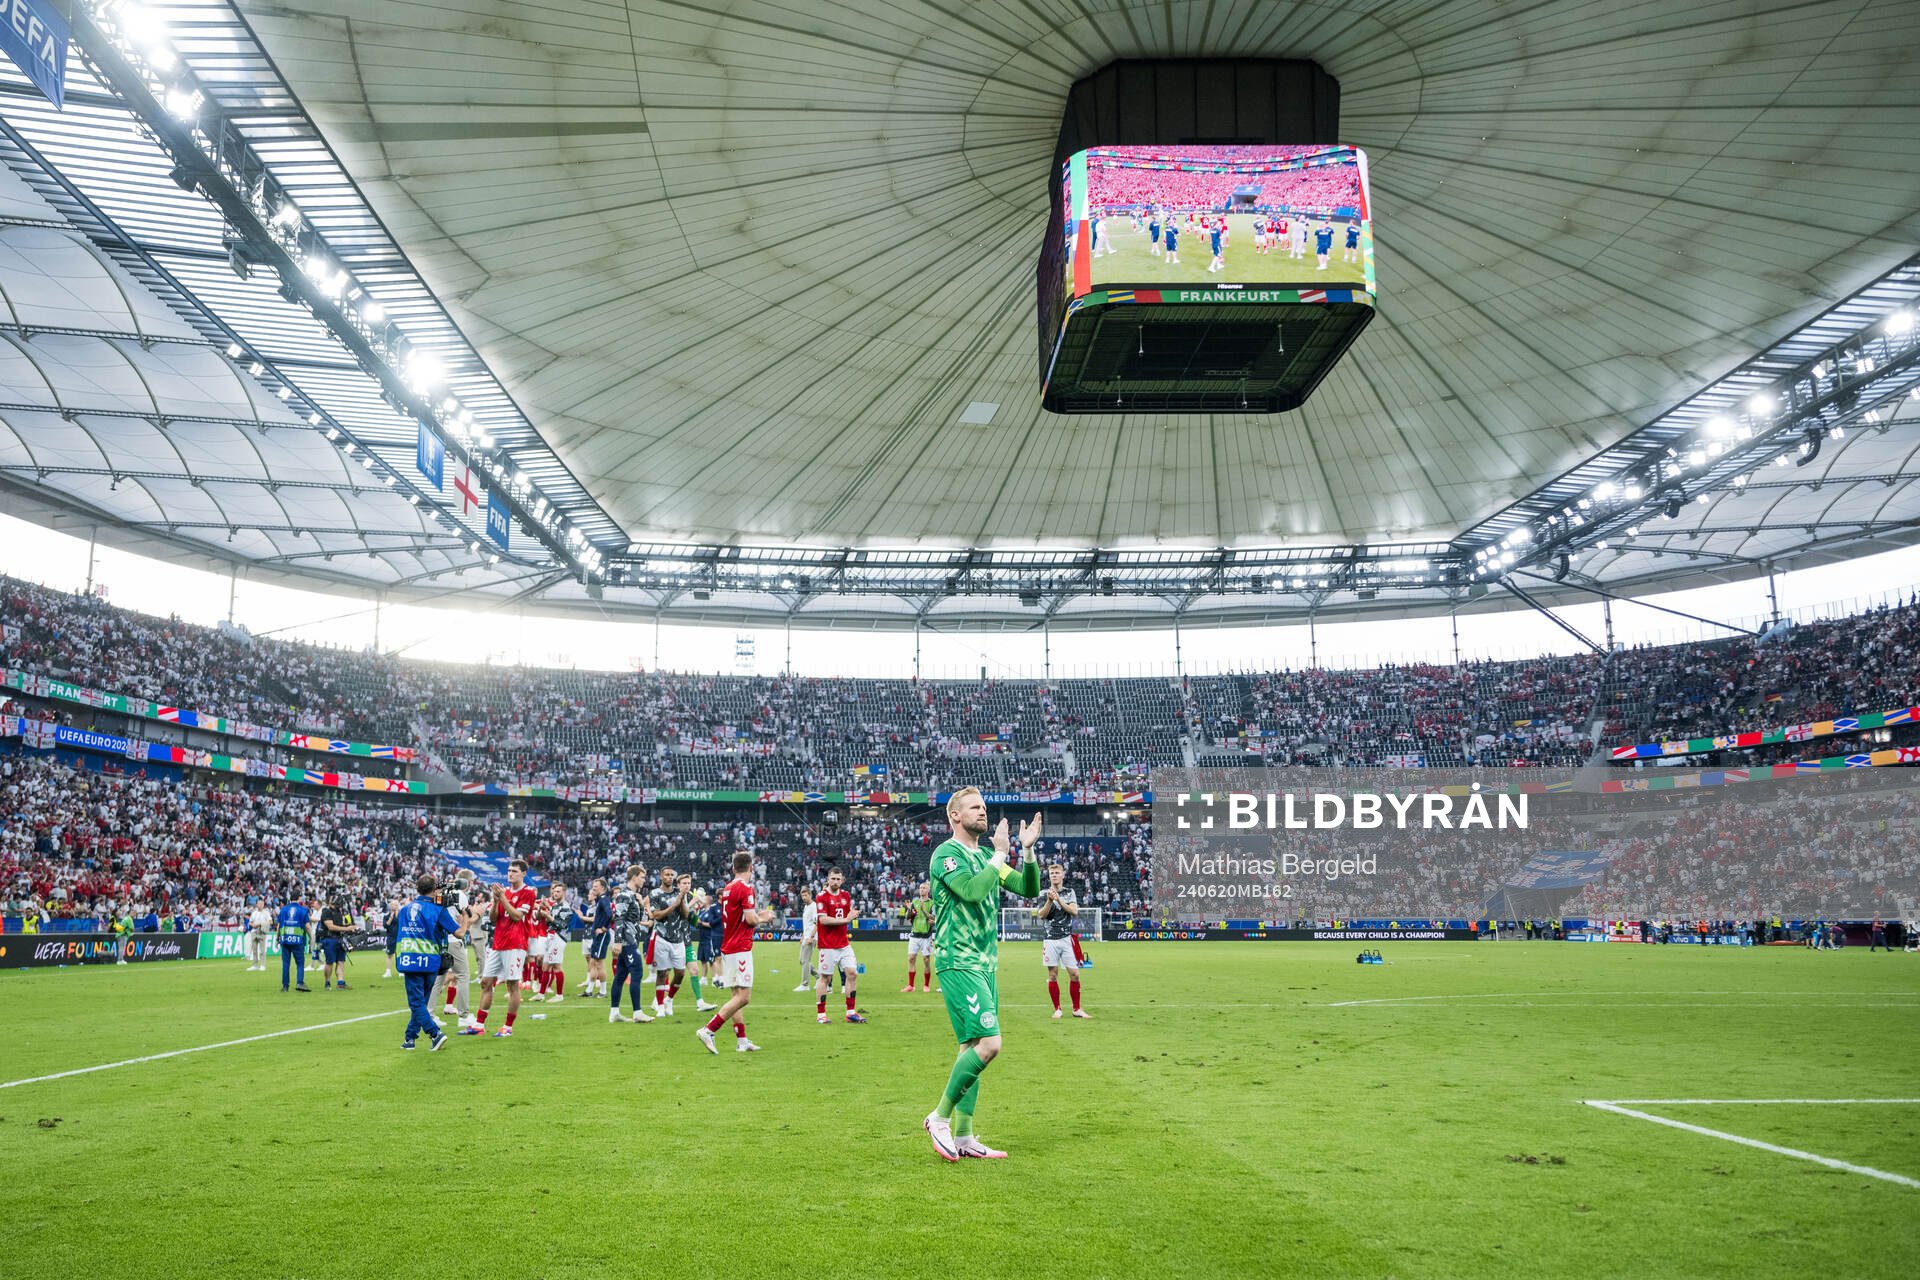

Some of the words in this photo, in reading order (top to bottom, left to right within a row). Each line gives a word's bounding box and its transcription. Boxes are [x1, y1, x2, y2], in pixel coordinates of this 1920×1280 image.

[1180, 291, 1280, 301] FRANKFURT
[489, 507, 507, 537] FIFA
[49, 683, 119, 707] FRANRT
[656, 790, 714, 799] RANKFURT
[835, 908, 844, 918] 23
[752, 932, 780, 940] ATION
[1117, 931, 1137, 940] UEFA
[34, 942, 66, 960] UEFA
[67, 941, 143, 959] FOUNDAION
[143, 940, 156, 961] for
[155, 941, 181, 955] children
